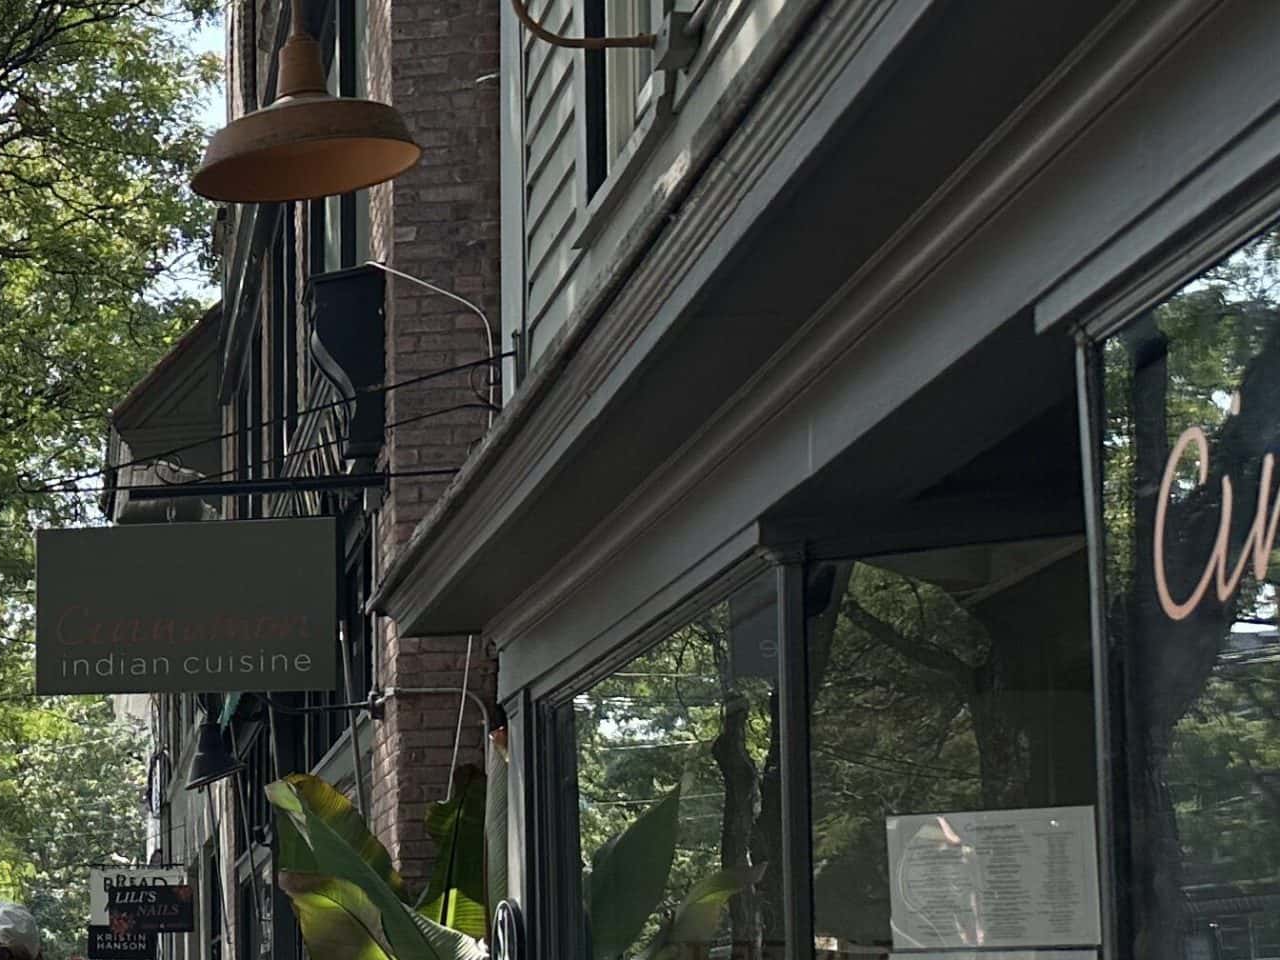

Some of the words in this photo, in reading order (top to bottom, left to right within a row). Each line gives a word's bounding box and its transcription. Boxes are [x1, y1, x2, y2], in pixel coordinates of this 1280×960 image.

[61, 652, 170, 678] indian
[183, 650, 313, 674] cuisine
[136, 904, 179, 917] NAILS
[96, 942, 147, 951] HANSON
